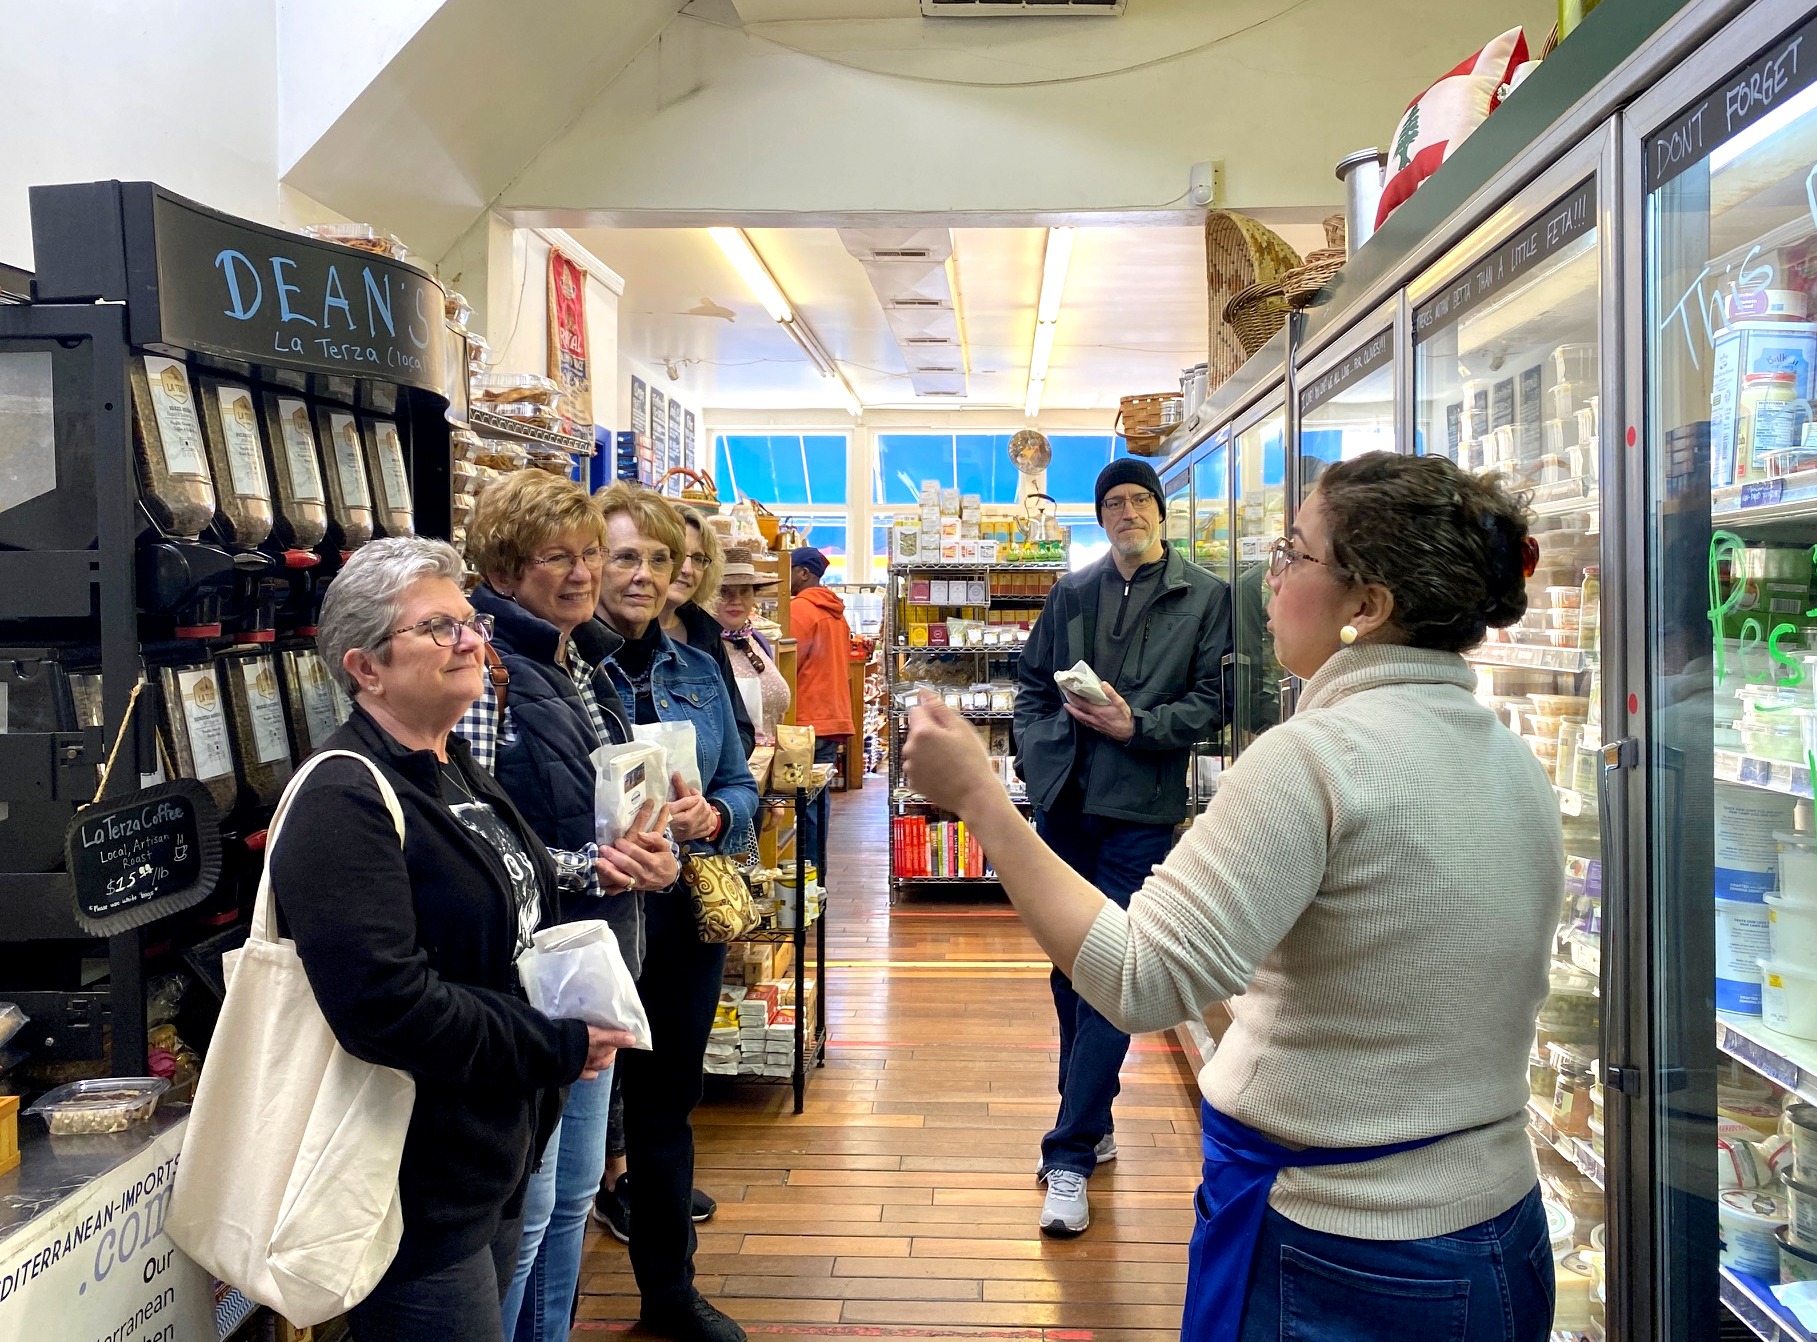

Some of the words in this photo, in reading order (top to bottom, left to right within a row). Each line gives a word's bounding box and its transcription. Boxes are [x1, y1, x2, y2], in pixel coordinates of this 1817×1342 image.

[1657, 102, 1709, 179] DONT
[1726, 36, 1803, 132] FORGET
[1497, 255, 1504, 280] A
[1511, 232, 1538, 272] LITTLE
[1546, 194, 1587, 249] FETA!!!
[215, 249, 429, 349] DEAN'S
[275, 331, 304, 355] La
[314, 338, 380, 364] Terza
[82, 826, 105, 849] La
[102, 815, 140, 841] Terza
[142, 803, 185, 829] Coffee
[100, 844, 131, 864] Local,
[133, 833, 170, 854] Artisan
[122, 850, 152, 870] Roast
[0, 1152, 182, 1302] DITERRANEAN-IMPORTS
[143, 1249, 174, 1284] Our
